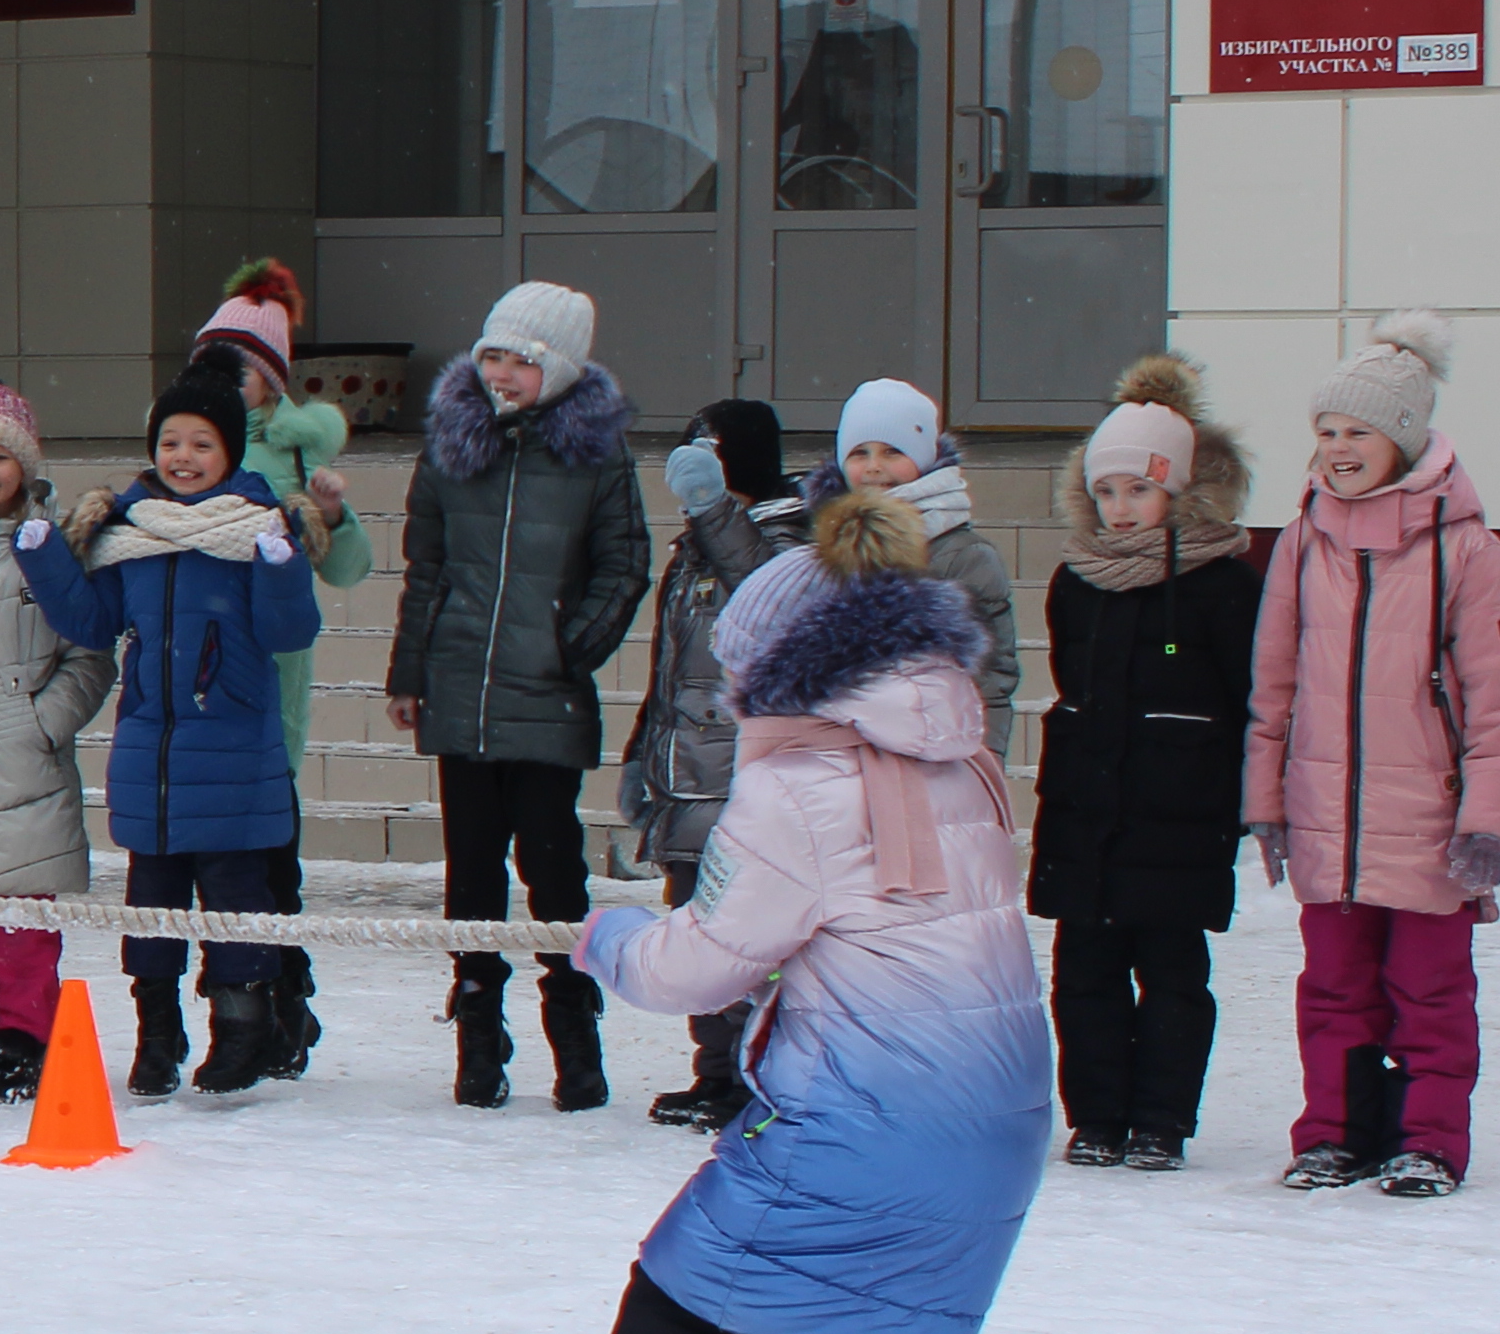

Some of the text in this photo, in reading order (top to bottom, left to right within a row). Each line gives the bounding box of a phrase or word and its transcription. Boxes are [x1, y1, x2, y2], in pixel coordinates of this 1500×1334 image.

[1219, 36, 1393, 56] ИЗБИРАТЕЛЬНОГО
[1407, 43, 1470, 62] №389
[1278, 57, 1393, 75] УЧАСТКА №
